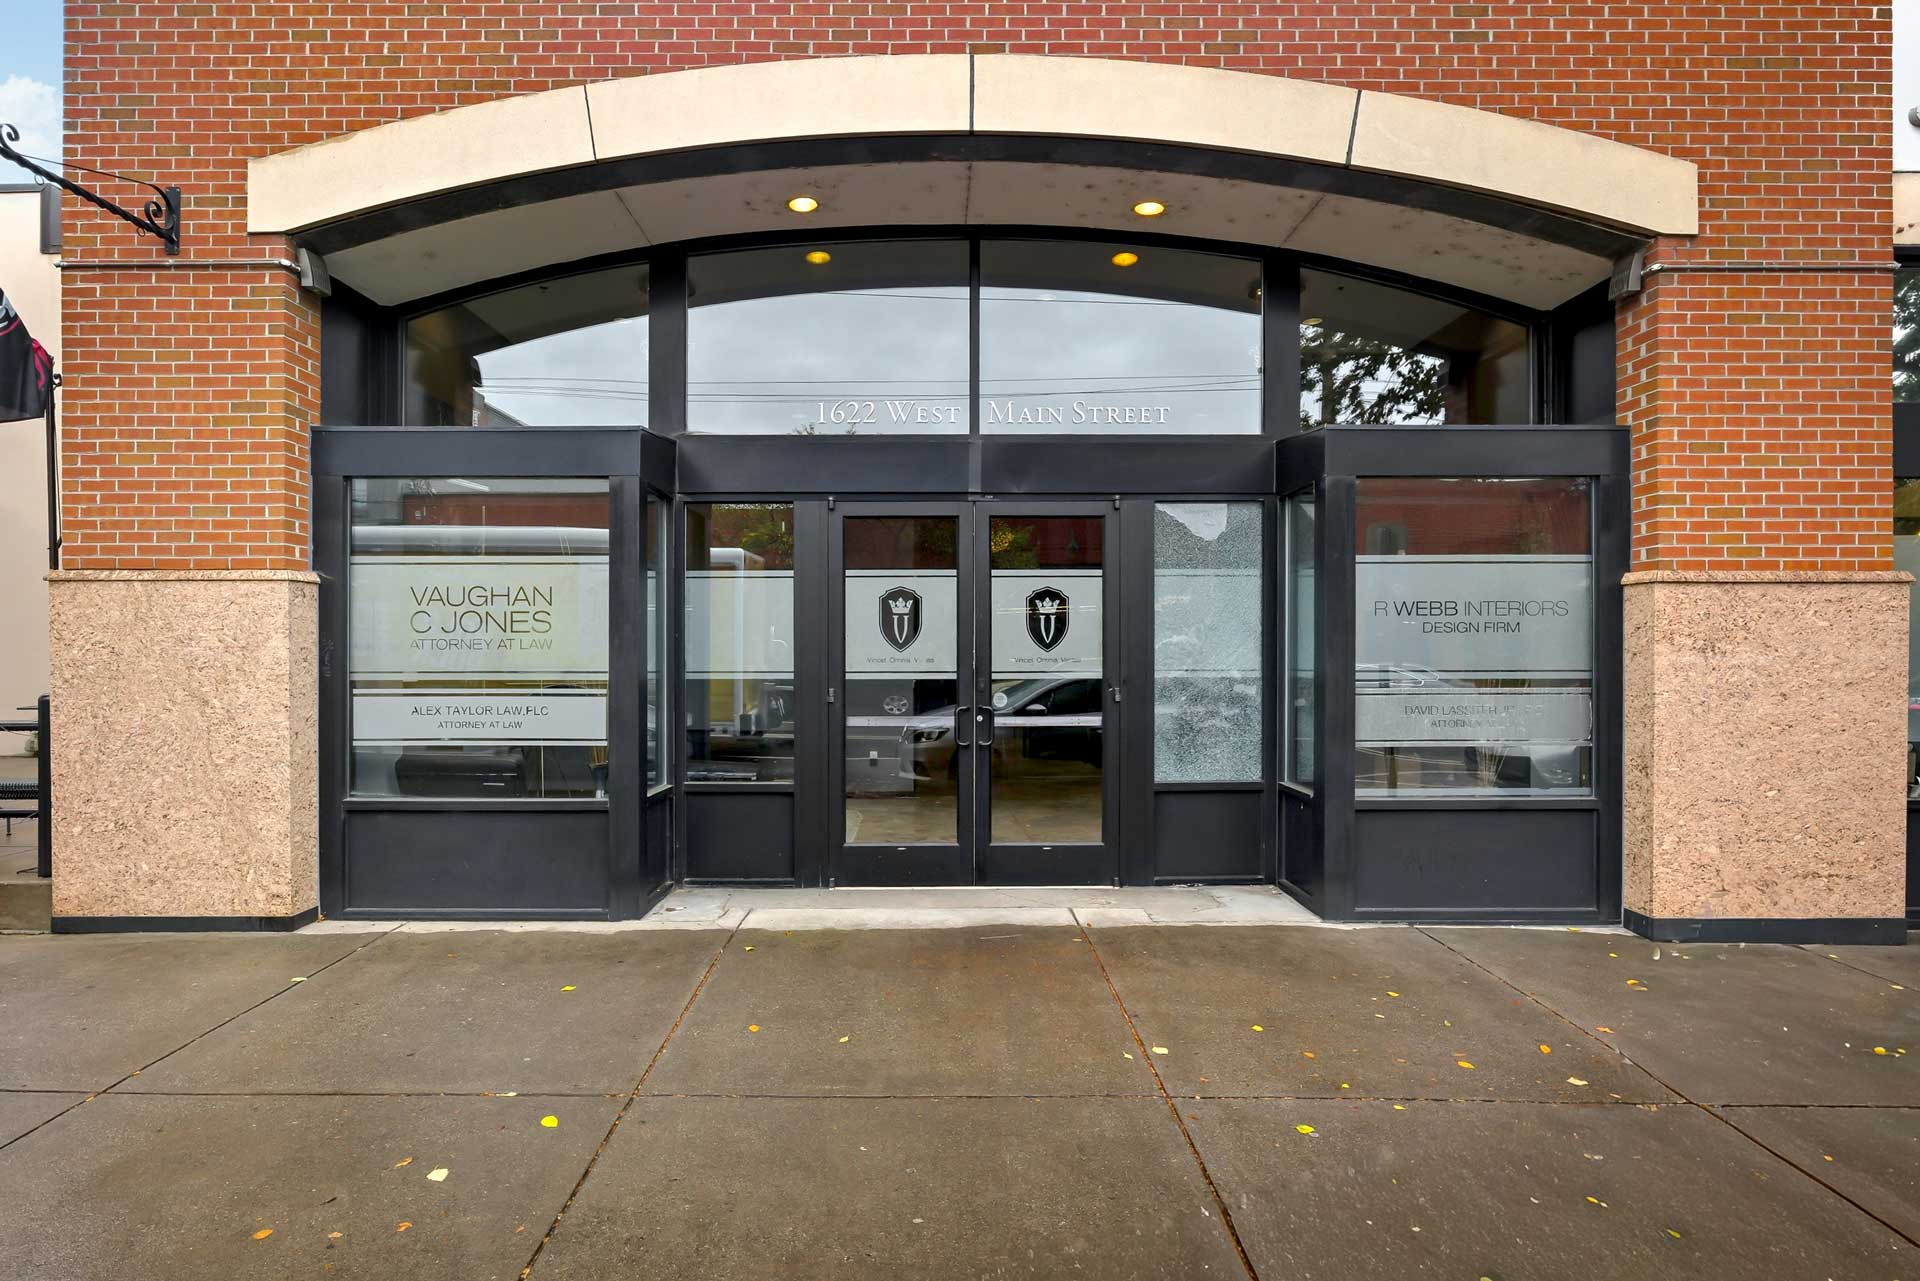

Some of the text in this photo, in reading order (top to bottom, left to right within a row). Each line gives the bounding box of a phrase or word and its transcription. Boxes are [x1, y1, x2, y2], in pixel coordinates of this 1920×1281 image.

[817, 401, 877, 424] 1622
[410, 586, 553, 607] VAUGHAN
[1374, 601, 1569, 617] R WEBB INTERIORS
[410, 610, 552, 634] C JONES
[1422, 621, 1521, 634] DESIGN FIRM
[410, 638, 553, 651] ATTORNEY AT LAW
[411, 706, 442, 717] ALEX
[445, 706, 493, 717] TAYLOR
[1404, 705, 1439, 716] DAVID
[437, 721, 523, 729] ATTORNEY AT LAW
